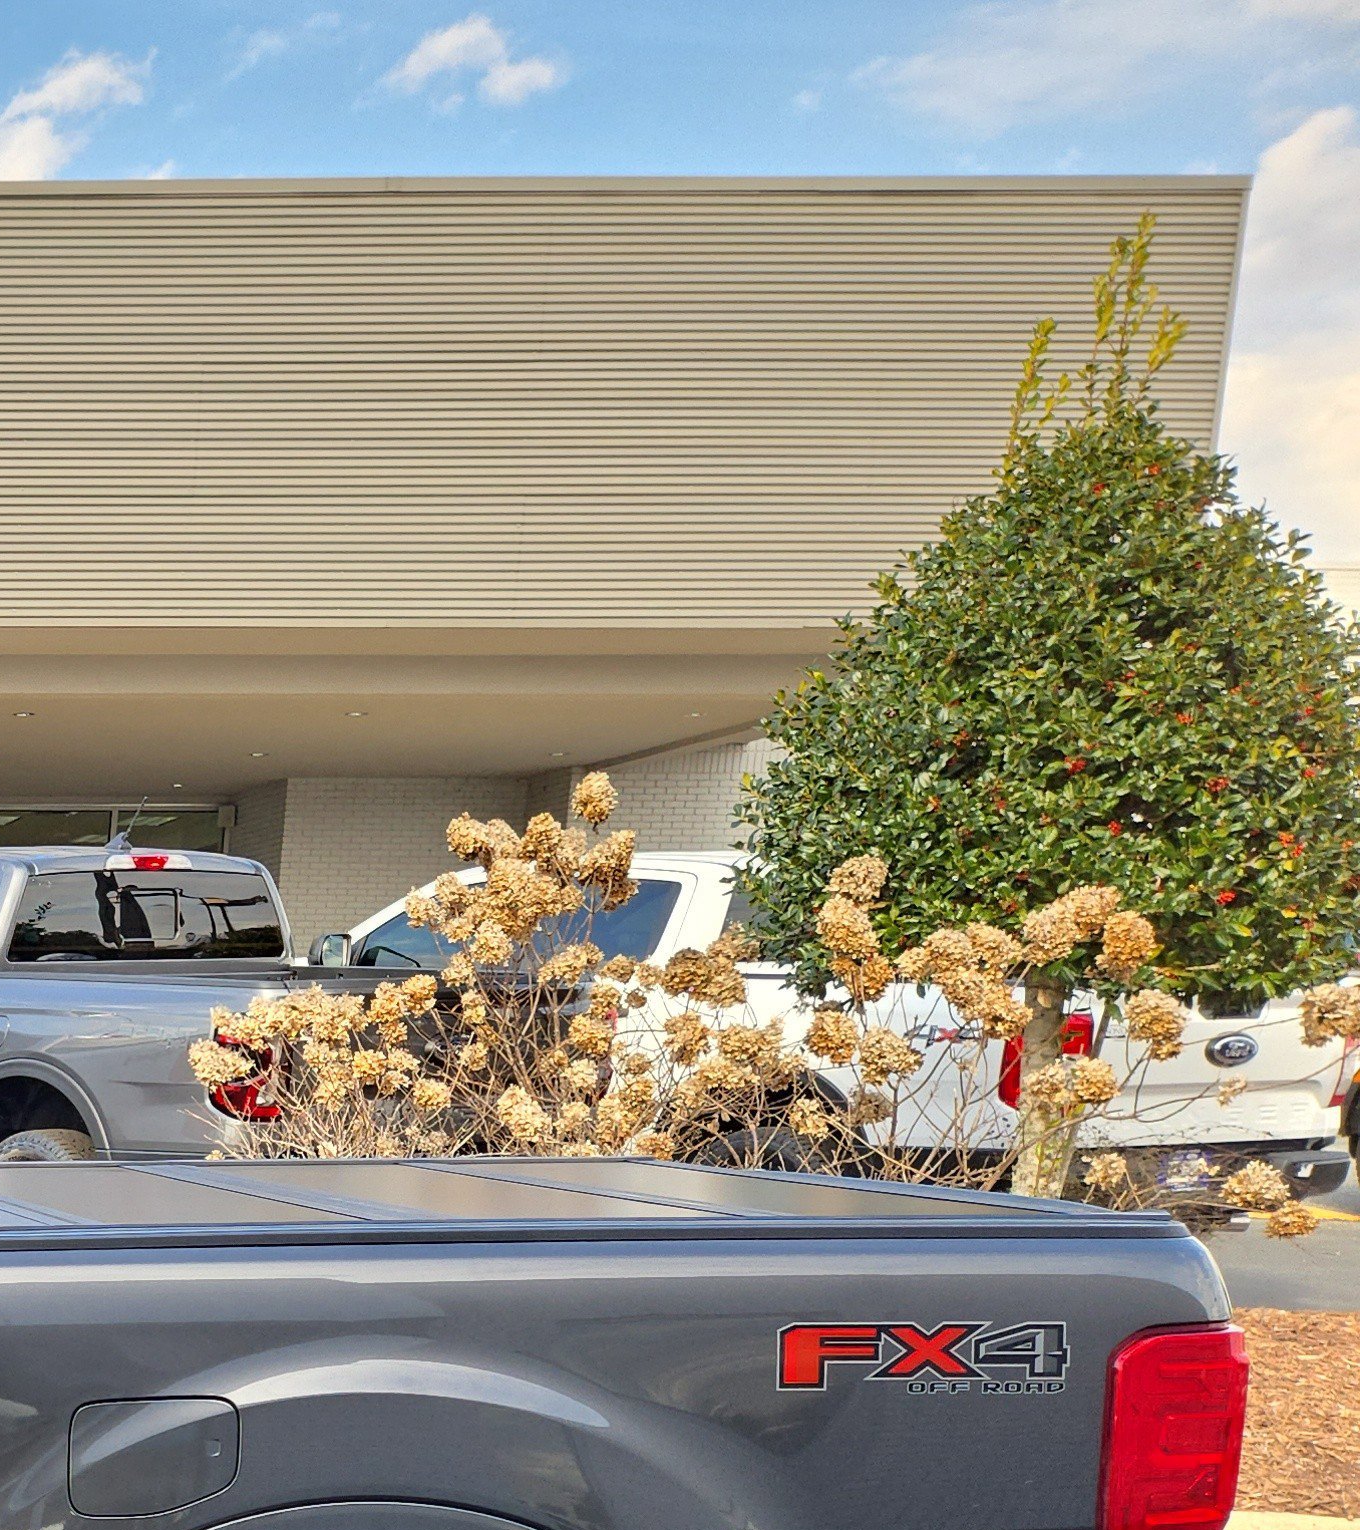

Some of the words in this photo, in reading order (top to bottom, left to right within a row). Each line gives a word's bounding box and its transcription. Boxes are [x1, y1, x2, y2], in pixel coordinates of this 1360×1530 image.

[776, 1321, 1071, 1391] FX4
[907, 1380, 971, 1395] OFF
[981, 1380, 1066, 1395] ROAD
